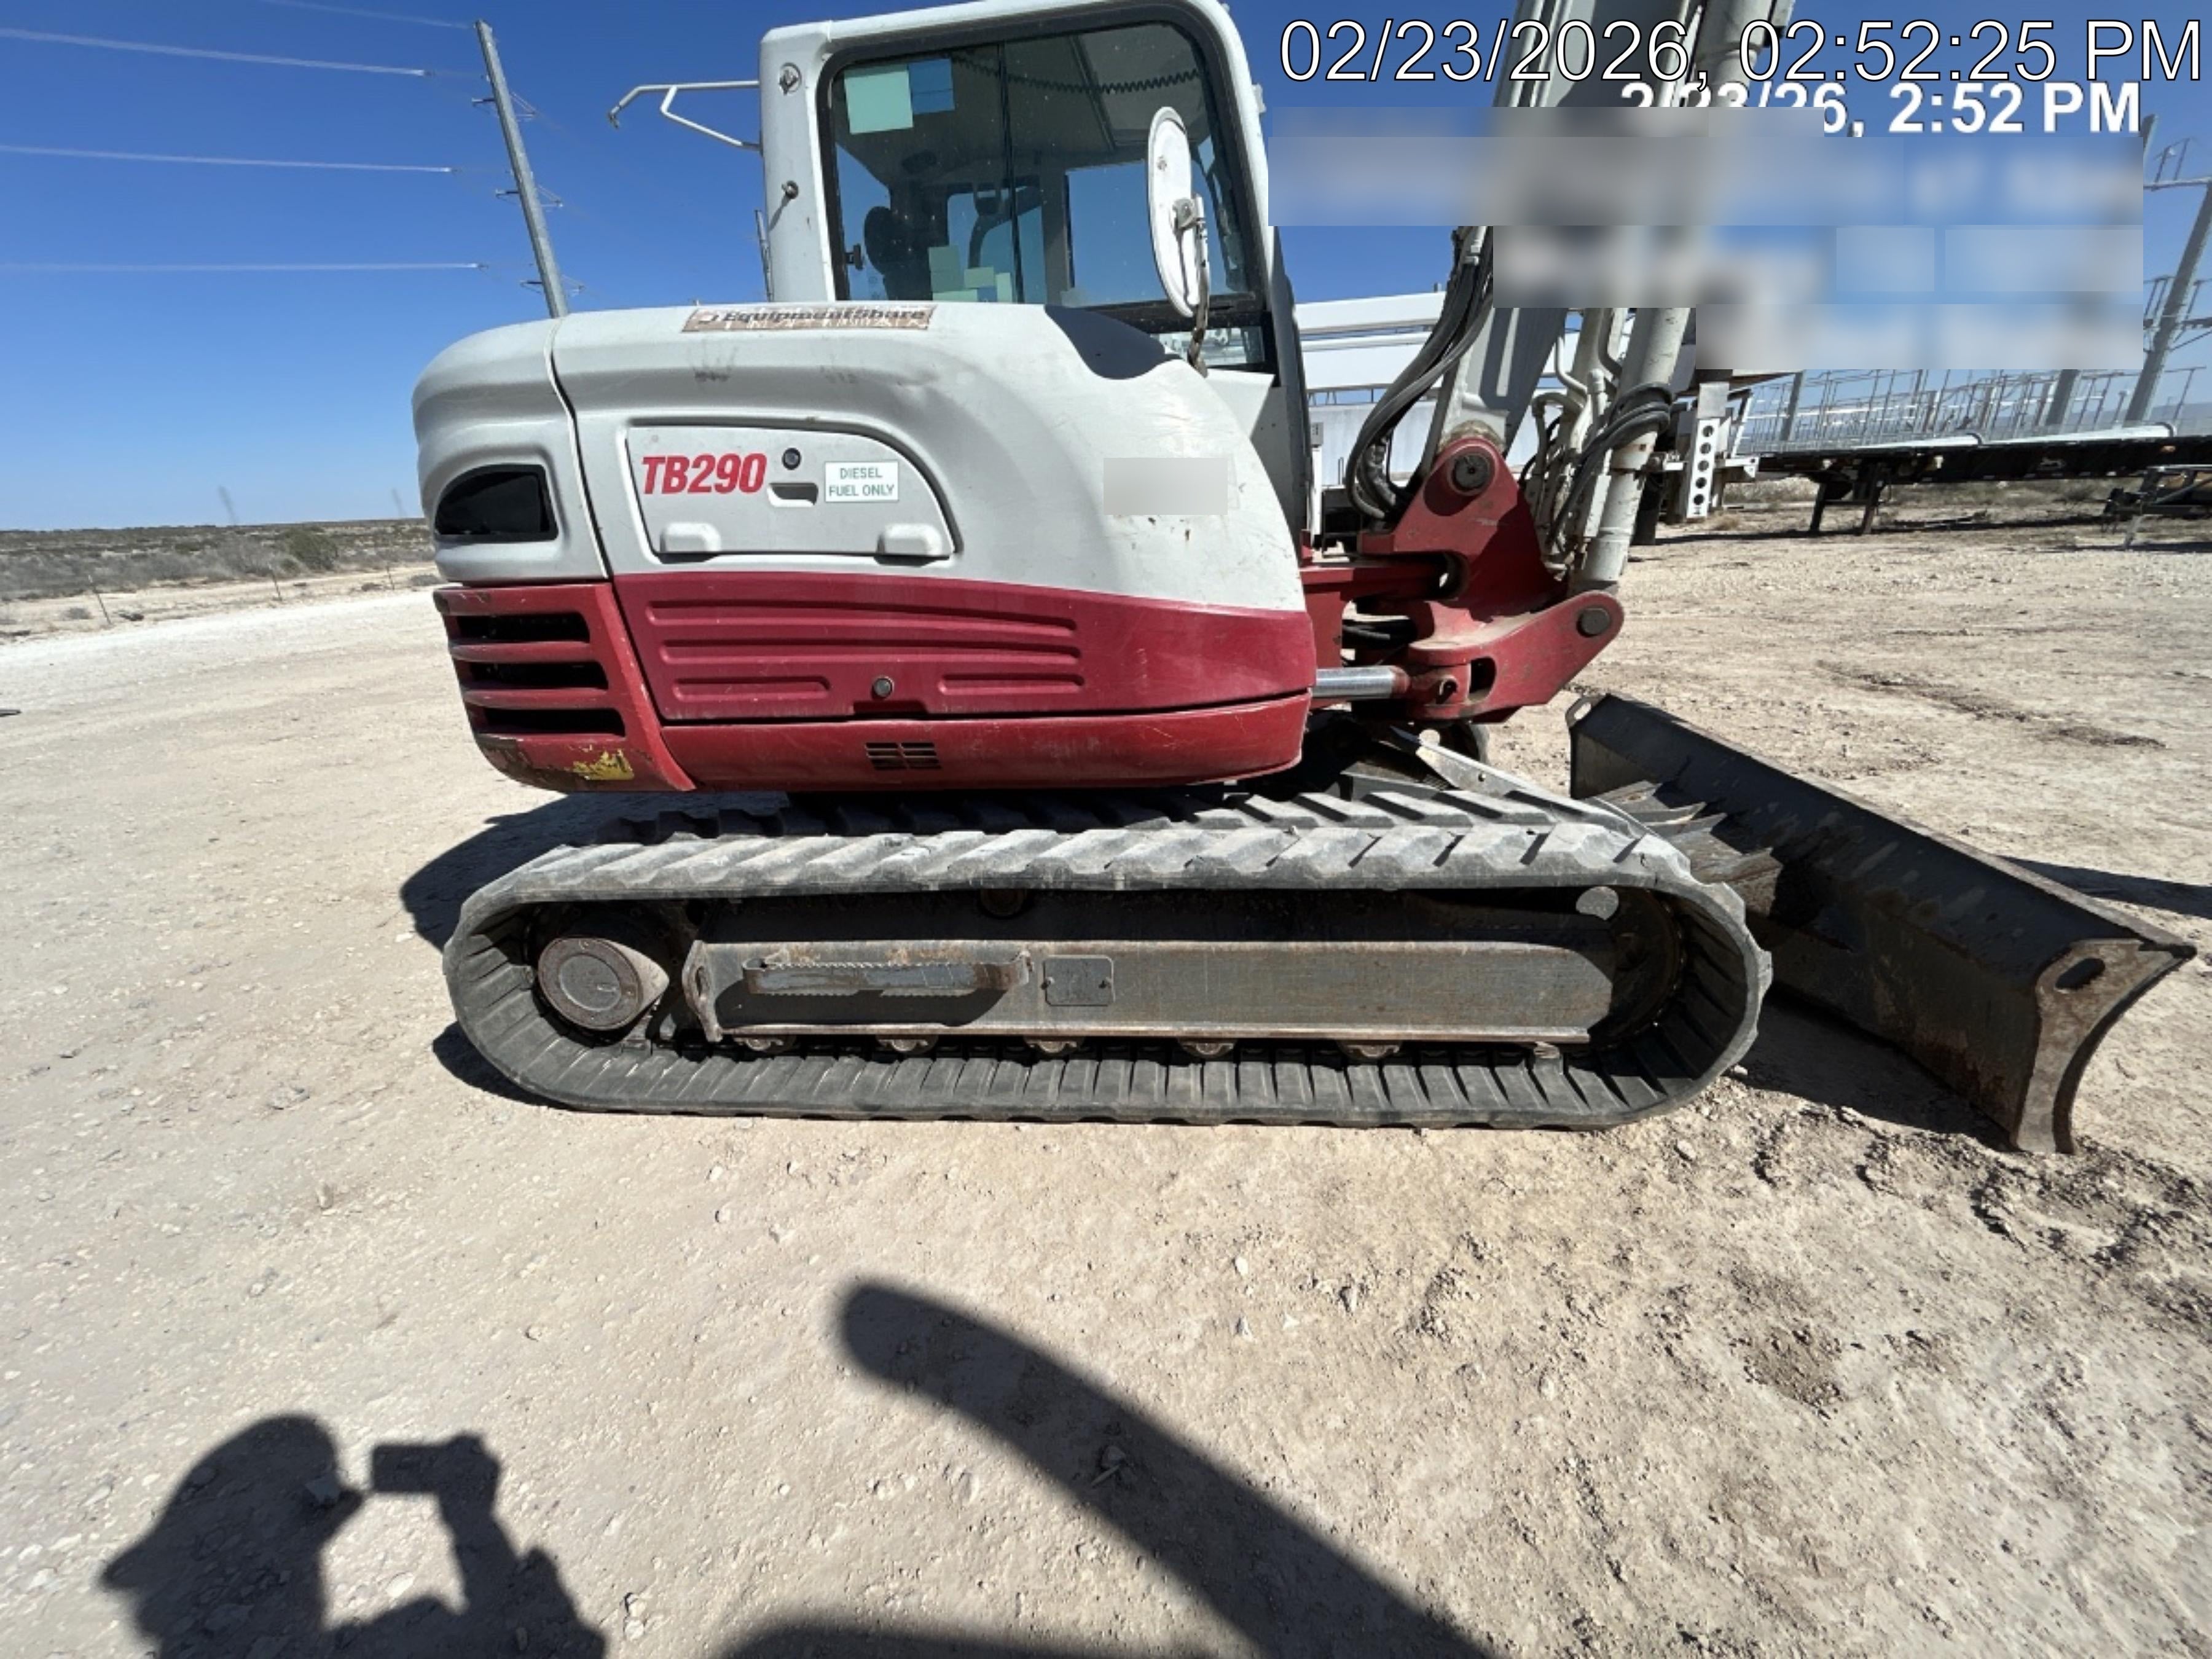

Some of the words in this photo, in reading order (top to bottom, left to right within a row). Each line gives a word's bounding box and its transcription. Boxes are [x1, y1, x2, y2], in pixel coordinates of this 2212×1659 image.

[642, 453, 767, 495] TB290
[839, 467, 882, 479] DIESEL
[829, 485, 858, 496] FUEL
[862, 484, 895, 496] ONLY
